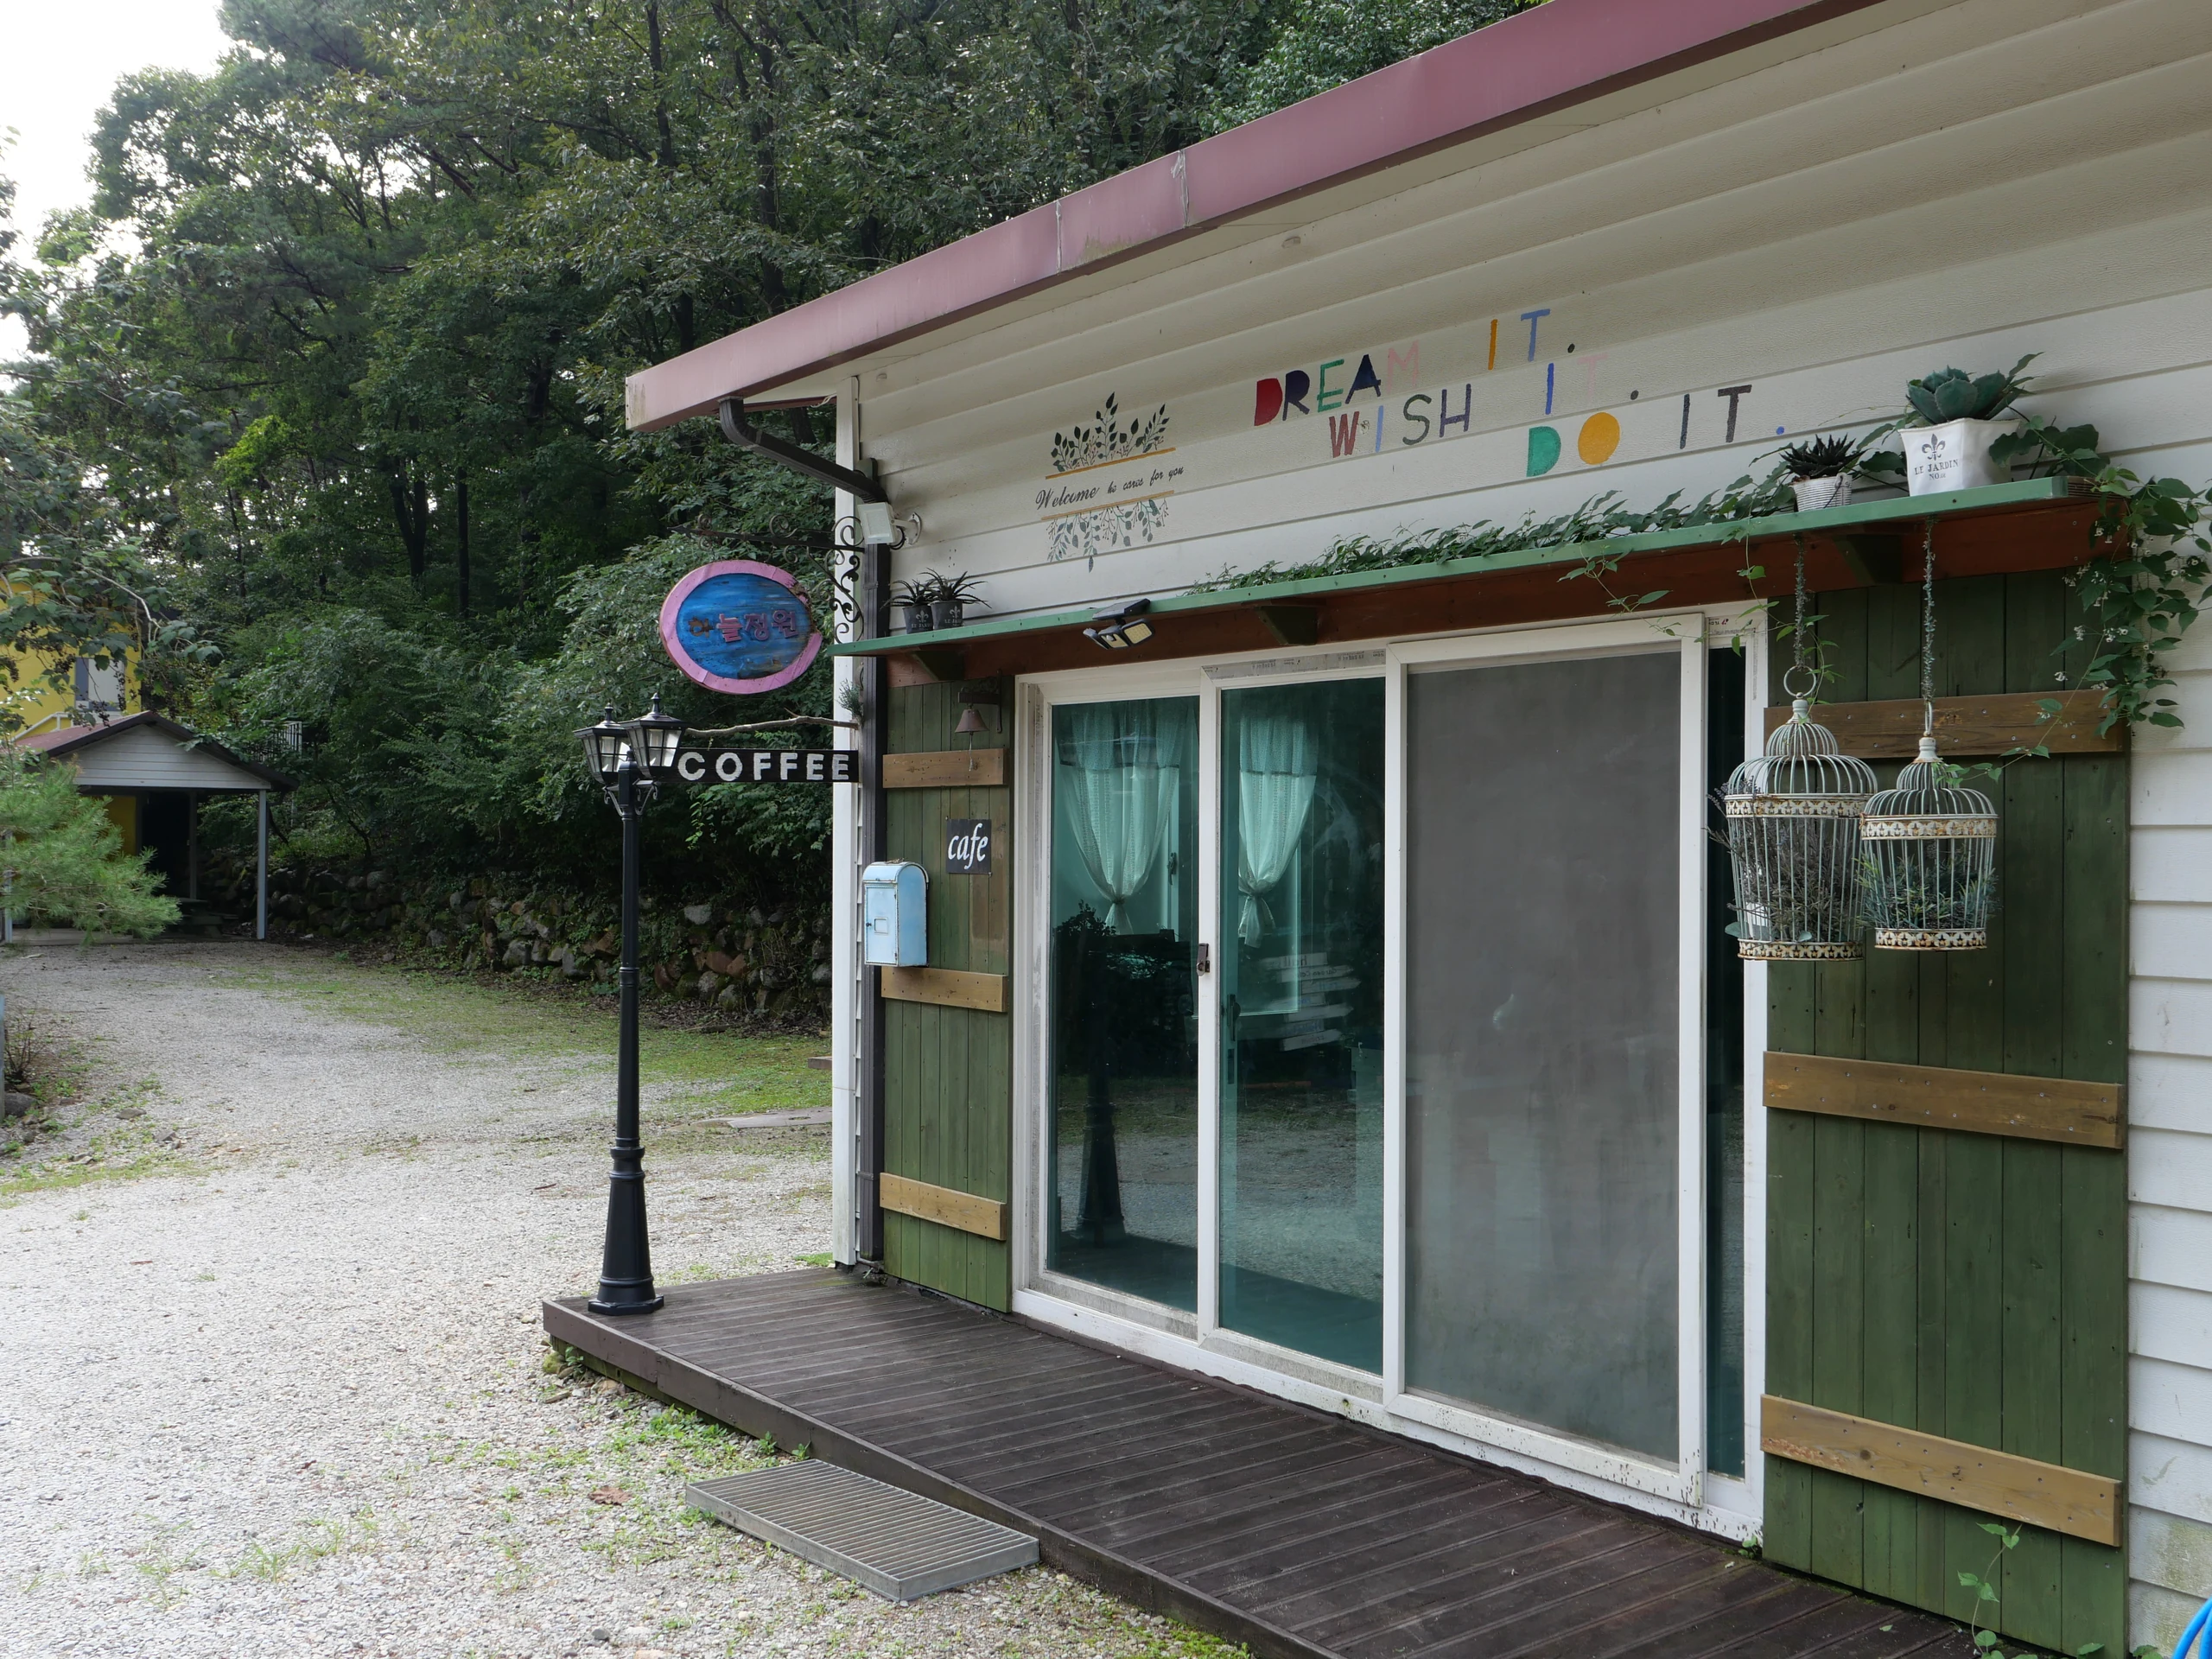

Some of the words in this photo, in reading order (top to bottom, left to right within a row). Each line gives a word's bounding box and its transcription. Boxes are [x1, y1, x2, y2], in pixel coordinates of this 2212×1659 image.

[1254, 340, 1420, 427] DREAM
[1486, 308, 1576, 371] IT.
[1328, 383, 1471, 459] WISH
[1526, 410, 1621, 478] DO
[1035, 486, 1100, 511] Welcome
[1123, 477, 1144, 492] cares
[1149, 468, 1164, 487] for
[1168, 466, 1185, 482] you
[1914, 465, 1924, 475] LE
[1927, 459, 1960, 473] JARDIN
[677, 751, 849, 782] COFFEE
[947, 823, 988, 870] cafe
